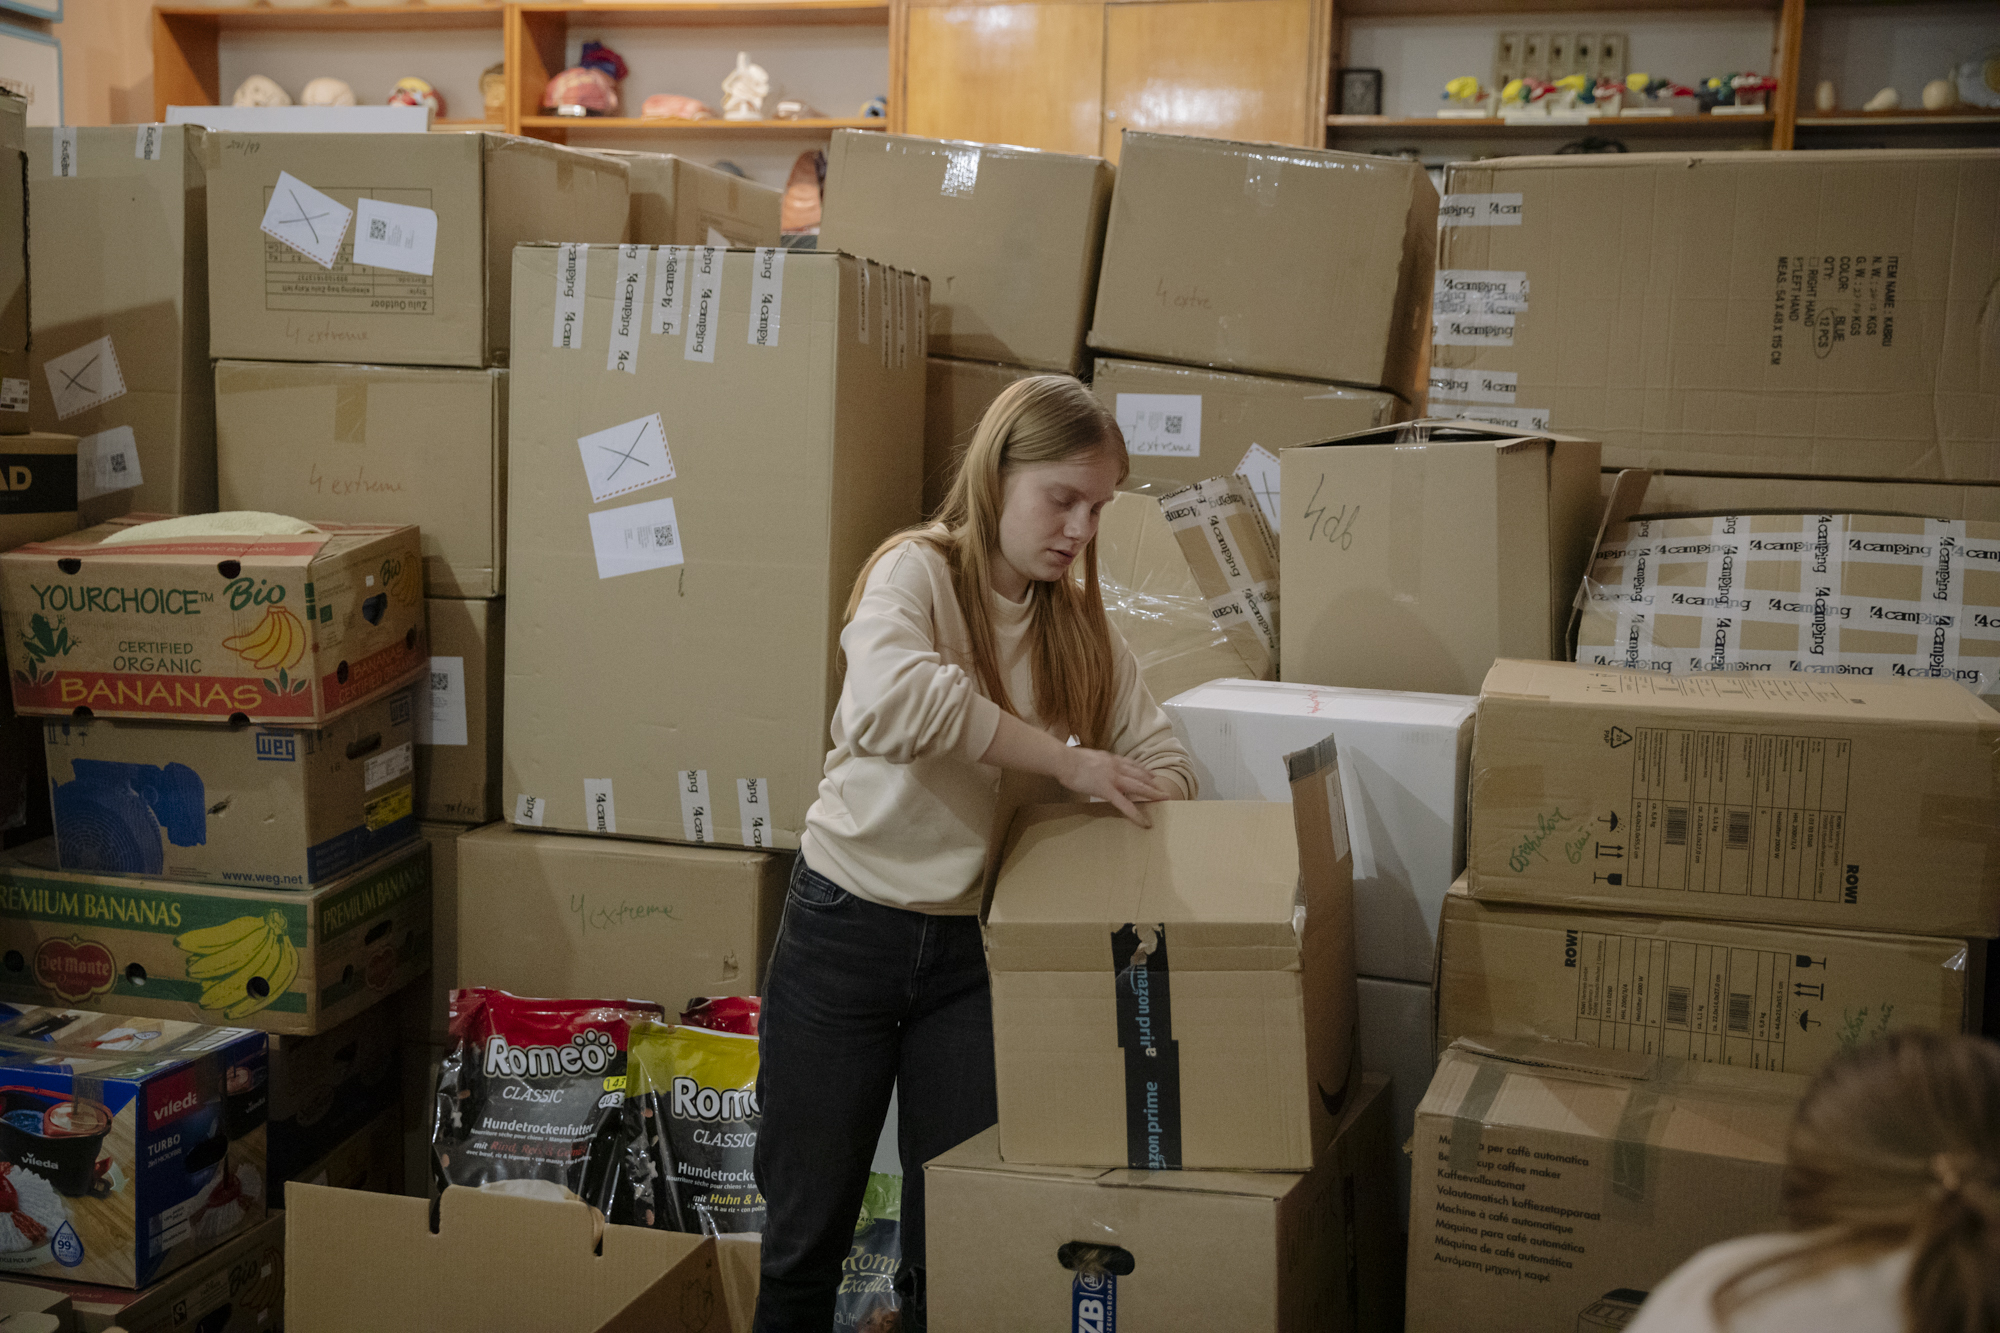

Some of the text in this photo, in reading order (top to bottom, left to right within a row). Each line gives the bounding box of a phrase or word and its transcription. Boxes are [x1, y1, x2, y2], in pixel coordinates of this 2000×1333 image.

[1887, 256, 1899, 279] ITEM
[1444, 279, 1506, 294] 4camping
[1775, 290, 1786, 302] 54
[1788, 269, 1803, 322] LEFT HAND
[1804, 269, 1819, 328] RIGHT HAND
[1883, 281, 1897, 309] NAME
[370, 300, 427, 311] Zulu Outdoor
[619, 274, 638, 337] 4camping
[1773, 312, 1784, 324] 48
[693, 288, 713, 353] 4camping
[1451, 323, 1514, 338] 4camping
[1818, 317, 1830, 348] 12 PCS
[1833, 316, 1847, 342] BLUE
[1850, 316, 1862, 336] KGS
[1866, 315, 1878, 336] KGS
[1771, 335, 1783, 349] 115
[1770, 351, 1782, 366] CM
[1208, 516, 1241, 578] 4camping
[1849, 539, 1933, 557] 4camping
[380, 558, 401, 587] Bio
[1631, 548, 1651, 603] 4camping
[1715, 546, 1738, 604] 4camping
[1933, 536, 1955, 601] 4camping
[223, 577, 286, 611] Bio
[1809, 514, 1833, 656] 4camping 4camping
[1870, 606, 1956, 628] 4camping
[118, 640, 194, 655] CERTIFIED
[113, 656, 202, 674] ORGANIC
[60, 678, 262, 710] BANANAS
[222, 870, 303, 886] www.weg.net
[1844, 865, 1860, 904] ROWI
[84, 893, 181, 928] BANANAS
[323, 886, 377, 935] PREMIUM
[1564, 929, 1579, 968] ROWI
[40, 953, 111, 976] Del Monte
[483, 1034, 608, 1079] Romeo
[502, 1085, 564, 1104] CLASSIC
[1143, 1081, 1163, 1133] prime
[482, 1117, 594, 1136] Hundetrockenfutter
[693, 1129, 756, 1148] CLASSIC
[147, 1133, 181, 1157] TURBO
[473, 1141, 488, 1150] mit
[490, 1140, 517, 1153] Rind,
[1487, 1144, 1589, 1167] per caffè automatica
[21, 1153, 59, 1171] vileda
[1497, 1162, 1561, 1180] coffee maker
[1437, 1168, 1526, 1191] Kaffeevollautomat
[692, 1193, 752, 1205] mit Huhn &
[1436, 1185, 1601, 1221] Volautomatisch koffiezetapparaat
[1436, 1201, 1574, 1234] Machine à café automatique
[59, 1234, 74, 1242] OVER
[1435, 1218, 1585, 1253] Máquina para café automática
[1434, 1235, 1573, 1269] Máquina de café automática
[229, 1260, 258, 1298] Bio
[1434, 1251, 1551, 1283] Αυτόματη μηχανή καφέ
